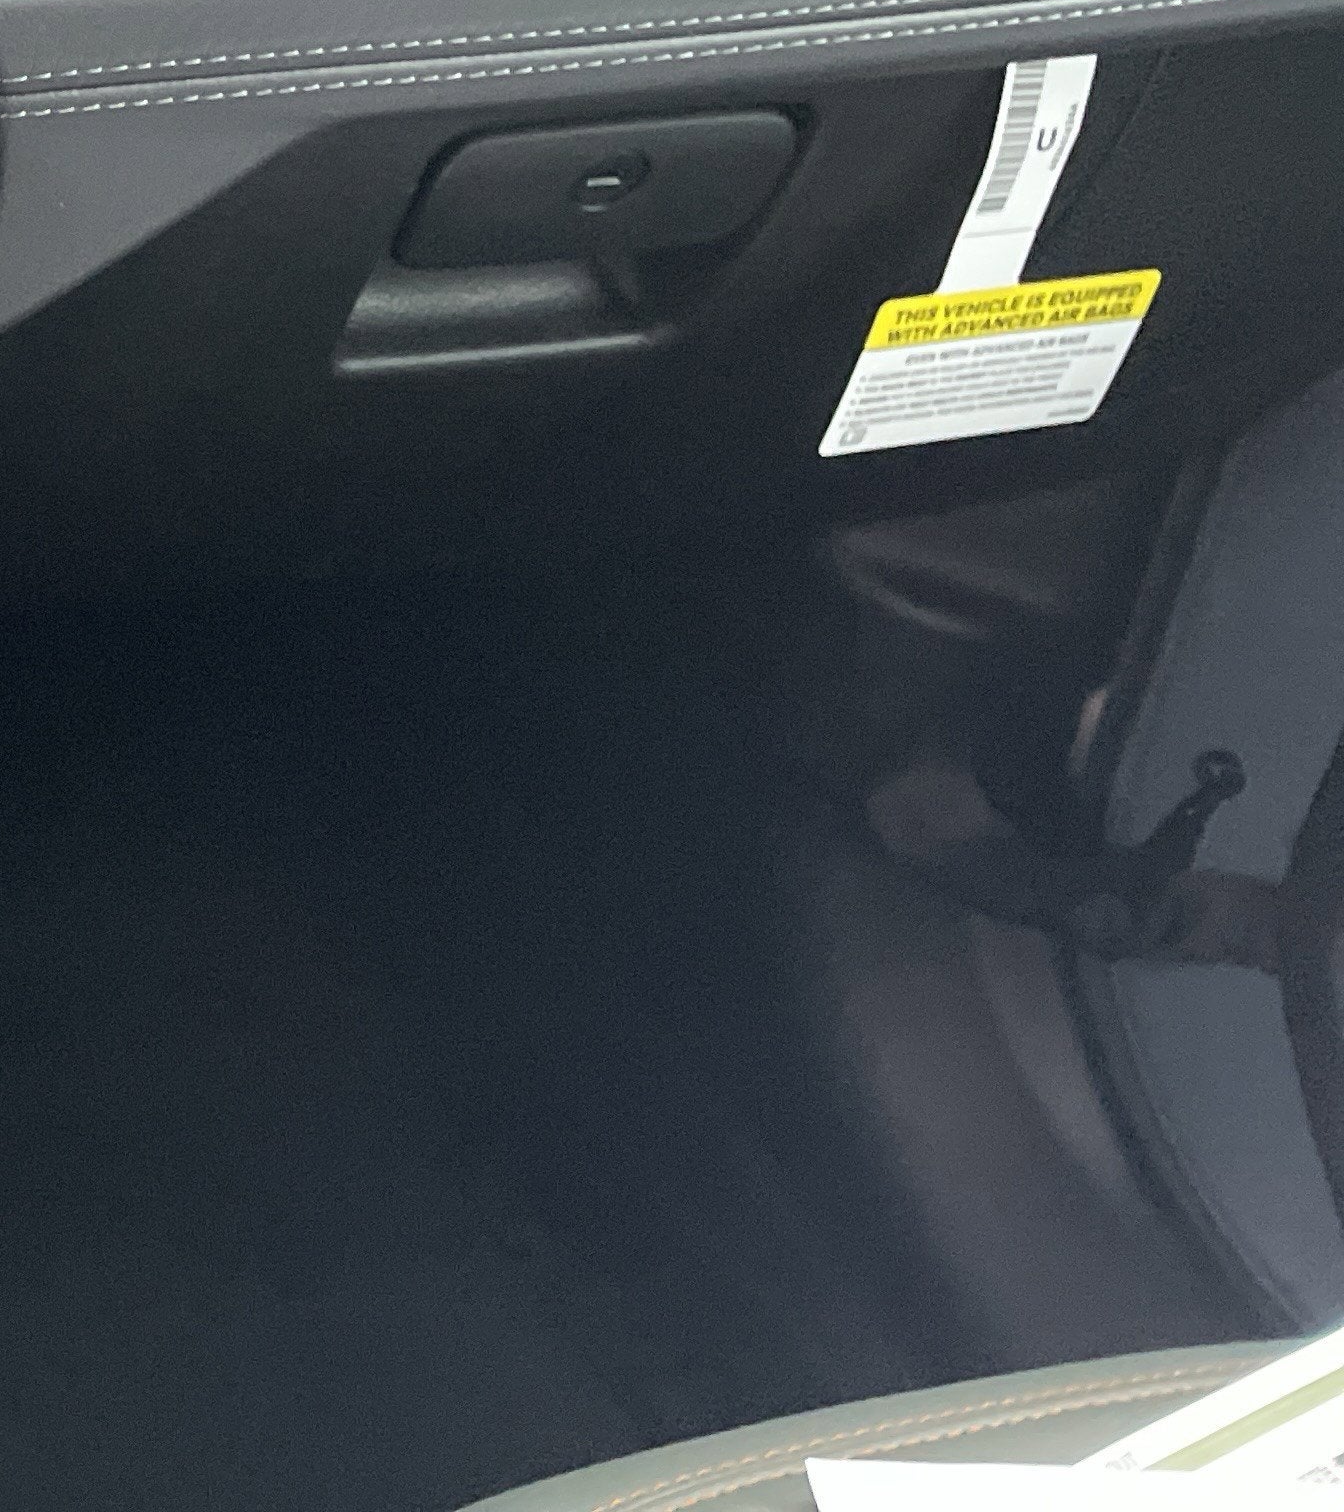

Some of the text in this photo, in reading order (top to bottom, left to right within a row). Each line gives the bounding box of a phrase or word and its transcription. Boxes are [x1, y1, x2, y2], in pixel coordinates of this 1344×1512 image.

[895, 282, 1143, 325] THIS VEHICLE IS EQUIPPED
[888, 324, 938, 343] WITH
[941, 311, 1046, 338] ADVANCED
[1050, 306, 1081, 323] AIR
